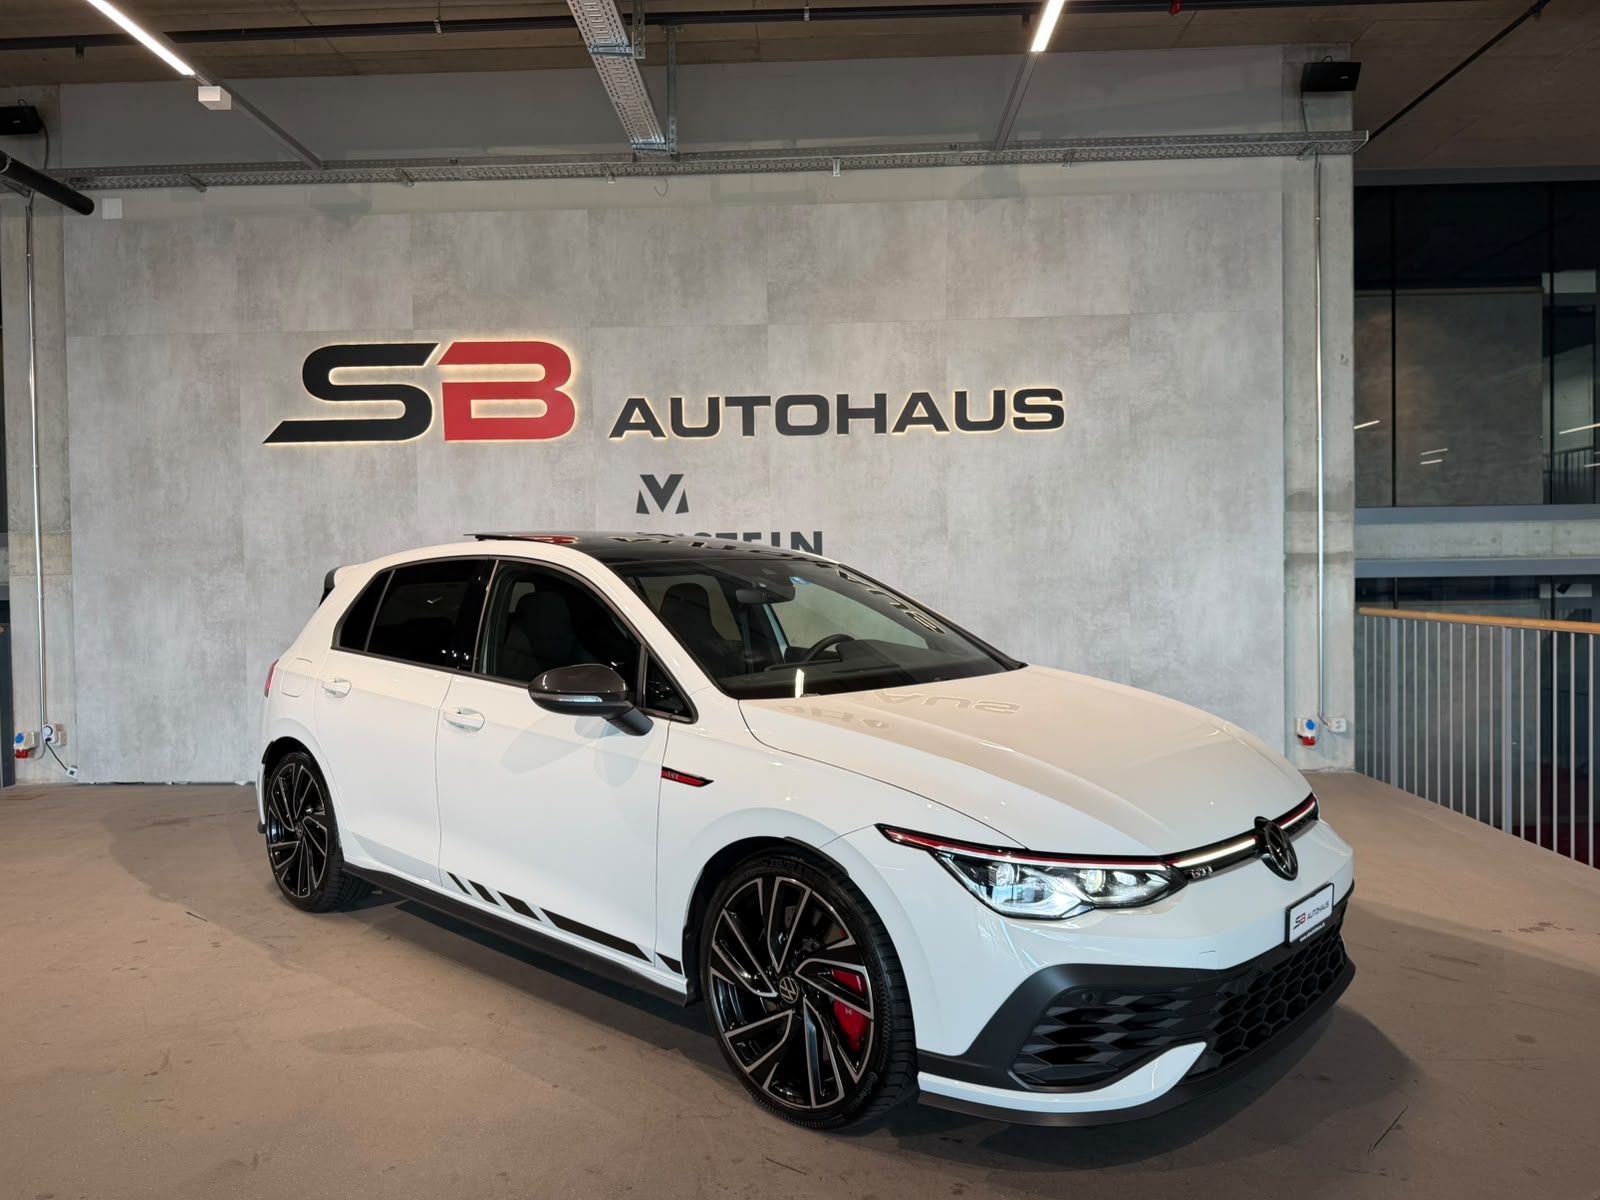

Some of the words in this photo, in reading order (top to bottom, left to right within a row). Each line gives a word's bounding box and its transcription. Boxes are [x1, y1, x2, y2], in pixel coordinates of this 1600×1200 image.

[263, 341, 575, 443] SB
[610, 387, 1064, 437] AUTOHAUS
[1293, 911, 1306, 930] SB
[1307, 900, 1330, 920] AUTOHAUS
